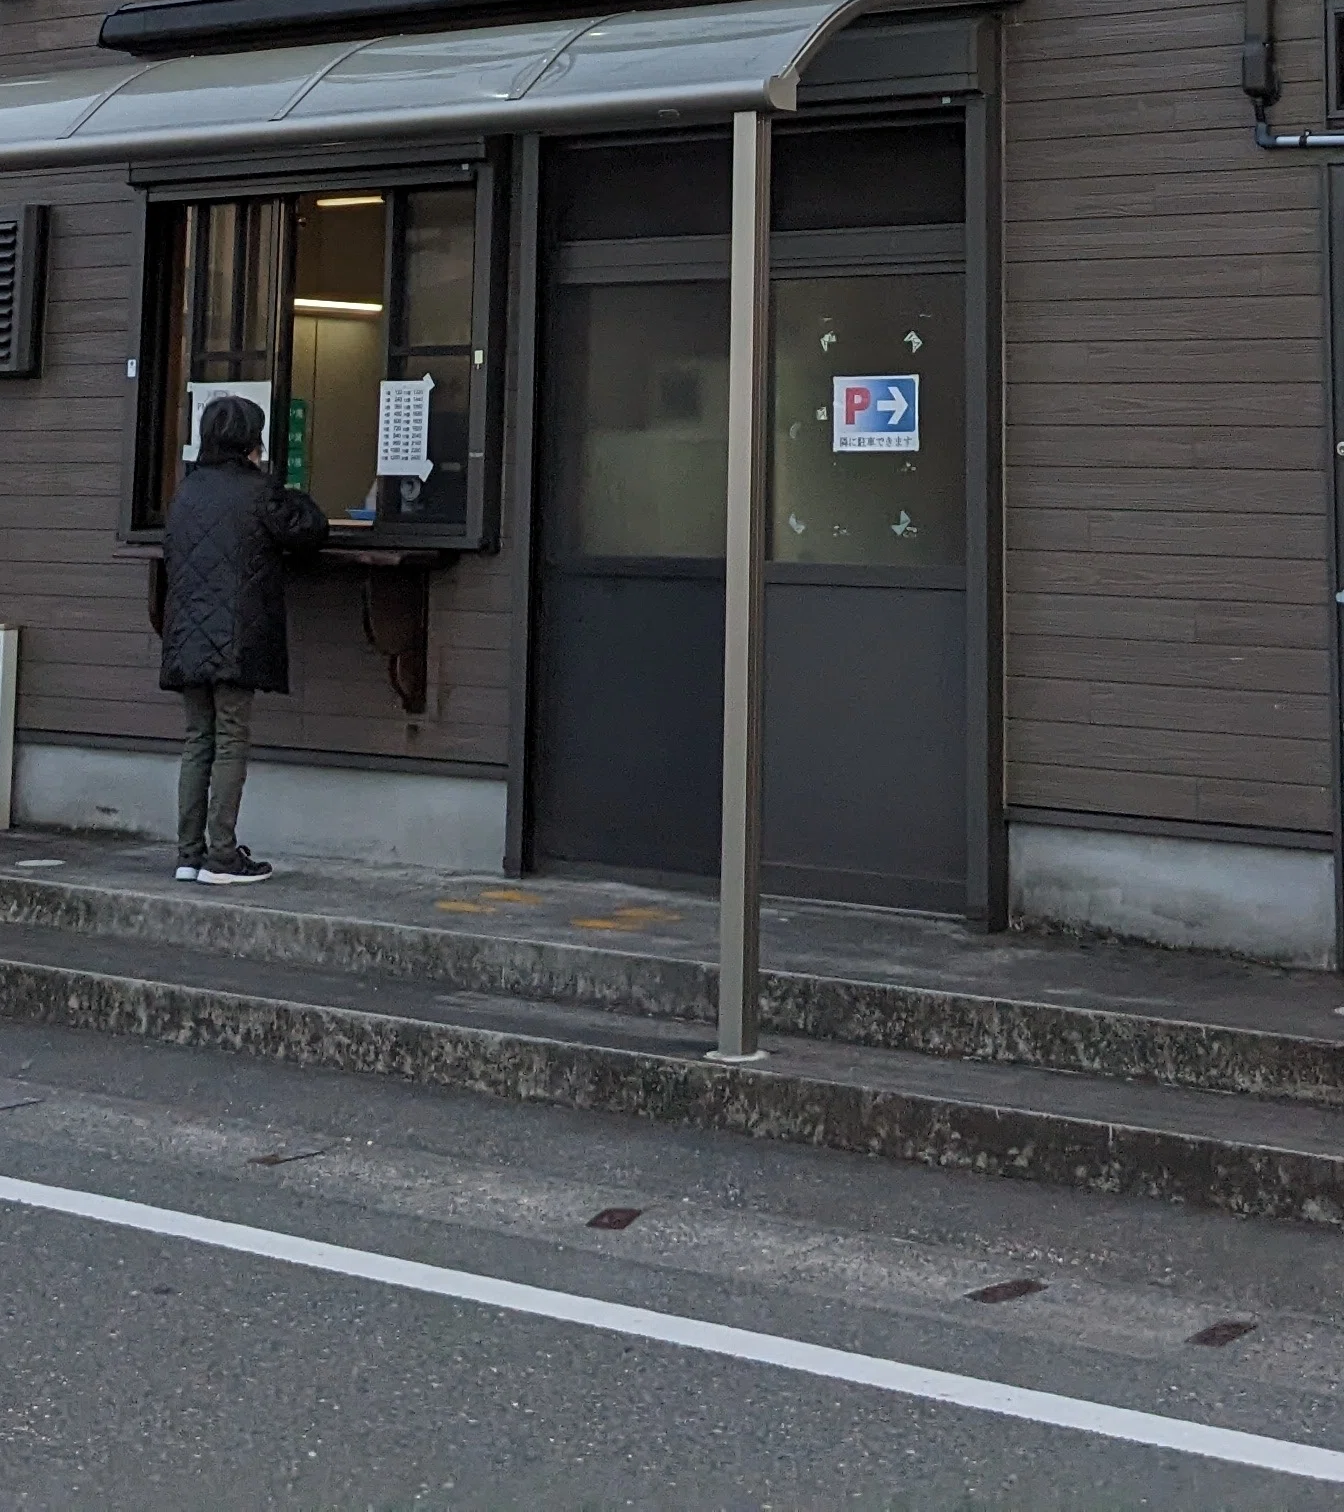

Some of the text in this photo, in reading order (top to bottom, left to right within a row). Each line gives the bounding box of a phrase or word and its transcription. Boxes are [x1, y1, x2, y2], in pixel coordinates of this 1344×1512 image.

[844, 387, 871, 425] P
[839, 436, 913, 448] 隣に駐車できます
